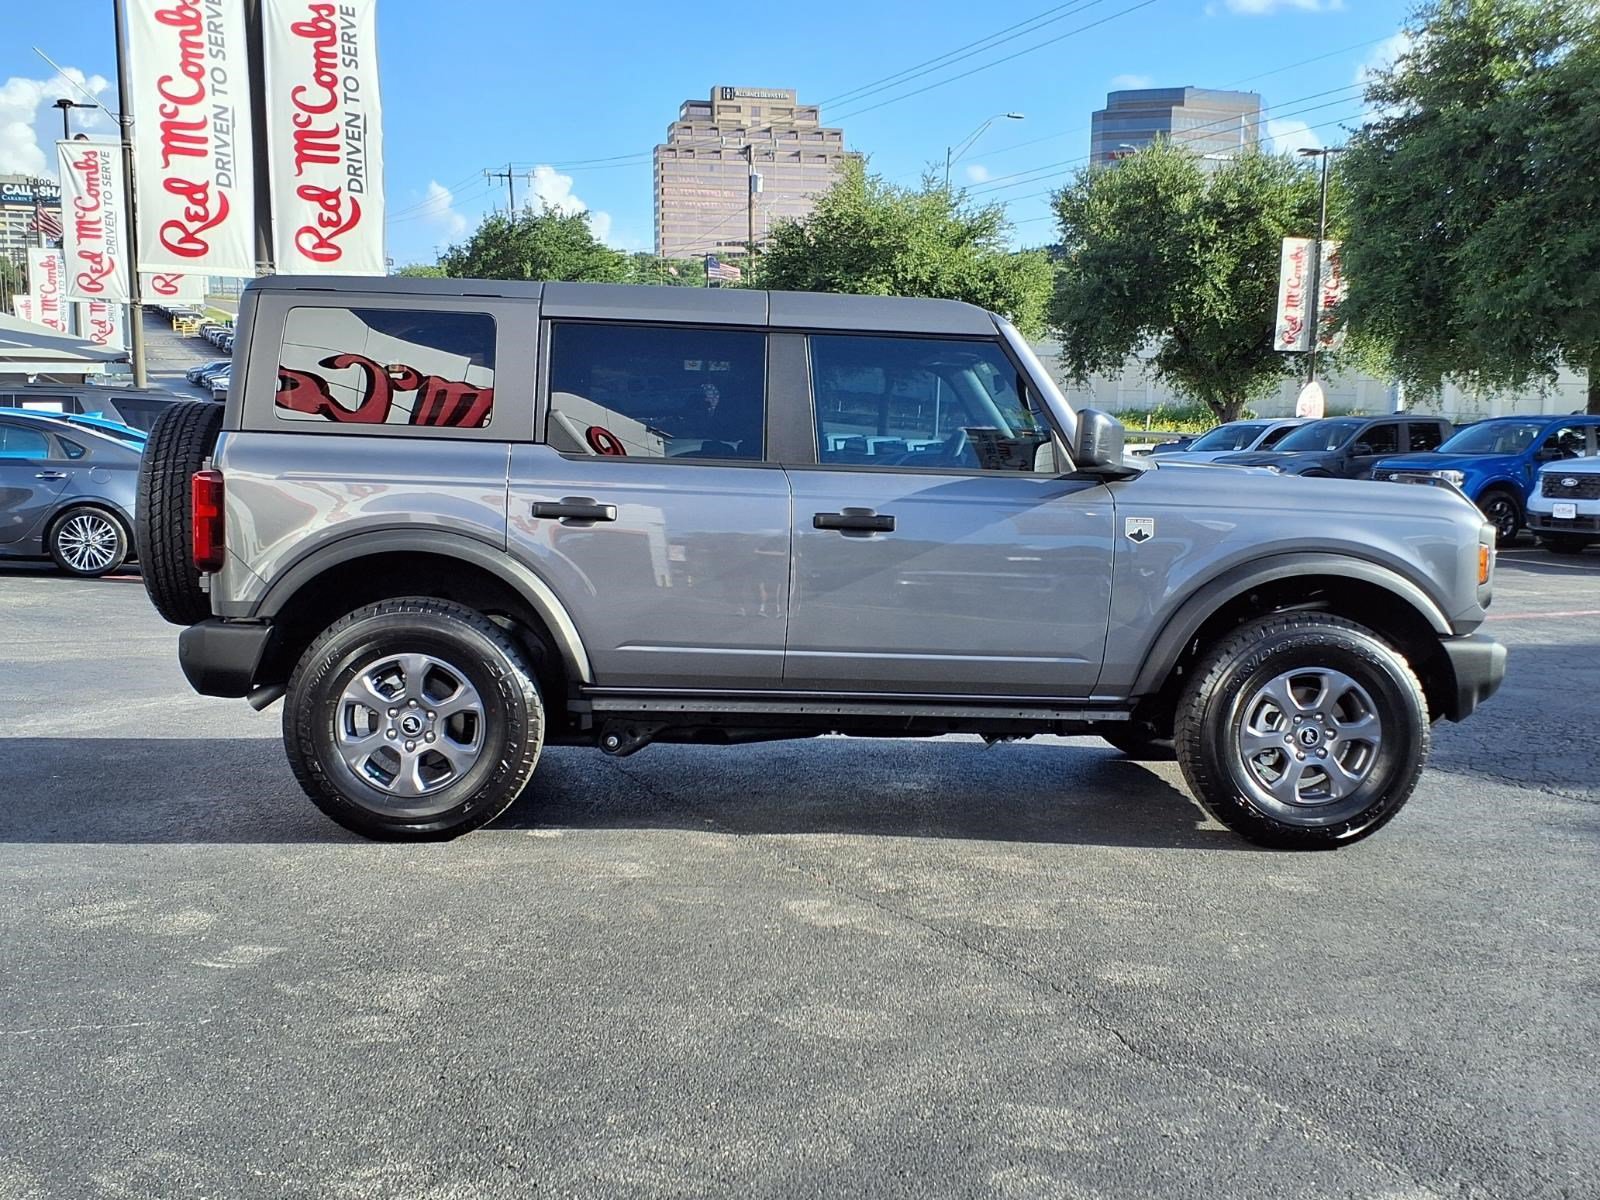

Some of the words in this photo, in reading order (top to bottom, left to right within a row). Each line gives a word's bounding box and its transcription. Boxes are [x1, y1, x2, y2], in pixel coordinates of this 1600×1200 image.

[340, 5, 359, 70] SERVE
[210, 66, 228, 97] TO
[291, 3, 341, 177] McCombs
[343, 75, 360, 105] TO
[100, 150, 112, 186] SERVE
[211, 105, 232, 189] DRIVEN
[344, 112, 364, 194] DRIVEN
[73, 150, 103, 245] McCombs
[103, 190, 113, 207] TO
[159, 177, 230, 258] Red
[295, 184, 362, 263] Red
[104, 211, 116, 255] DRIVEN
[39, 254, 58, 316] McCombs
[77, 250, 115, 293] Red
